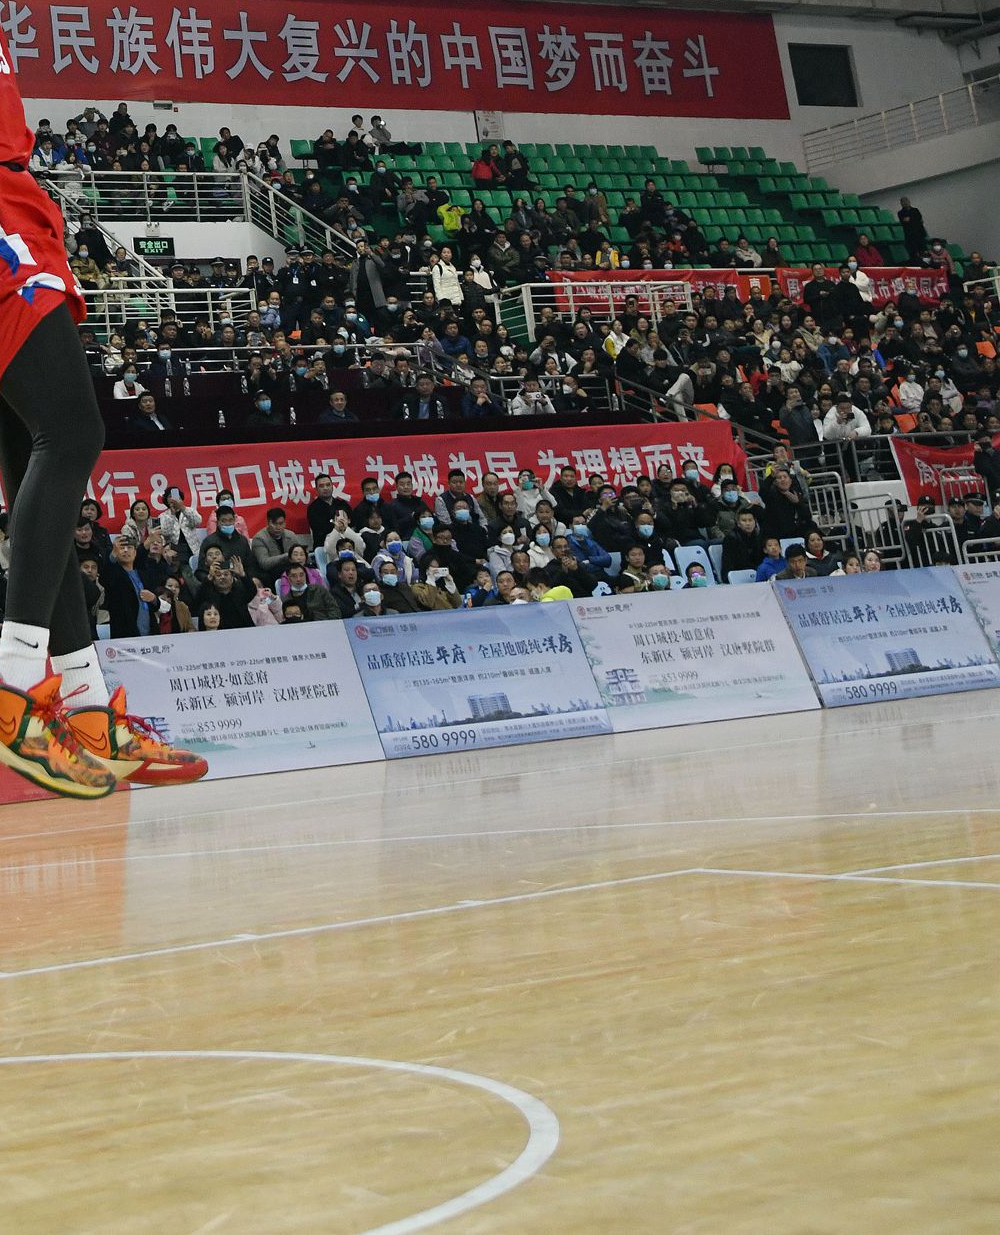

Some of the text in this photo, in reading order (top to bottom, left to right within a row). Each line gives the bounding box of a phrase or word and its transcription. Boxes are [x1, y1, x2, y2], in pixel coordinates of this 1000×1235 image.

[139, 240, 169, 249] 安全出口
[169, 670, 269, 693] 周口城投·如意府
[845, 685, 867, 699] 580
[870, 681, 897, 696] 9999
[176, 694, 217, 712] 东新区
[273, 682, 340, 703] 汉唐墅院群
[197, 720, 216, 733] 853
[218, 718, 242, 731] 9999
[411, 734, 439, 750] 580
[442, 730, 477, 747] 9999
